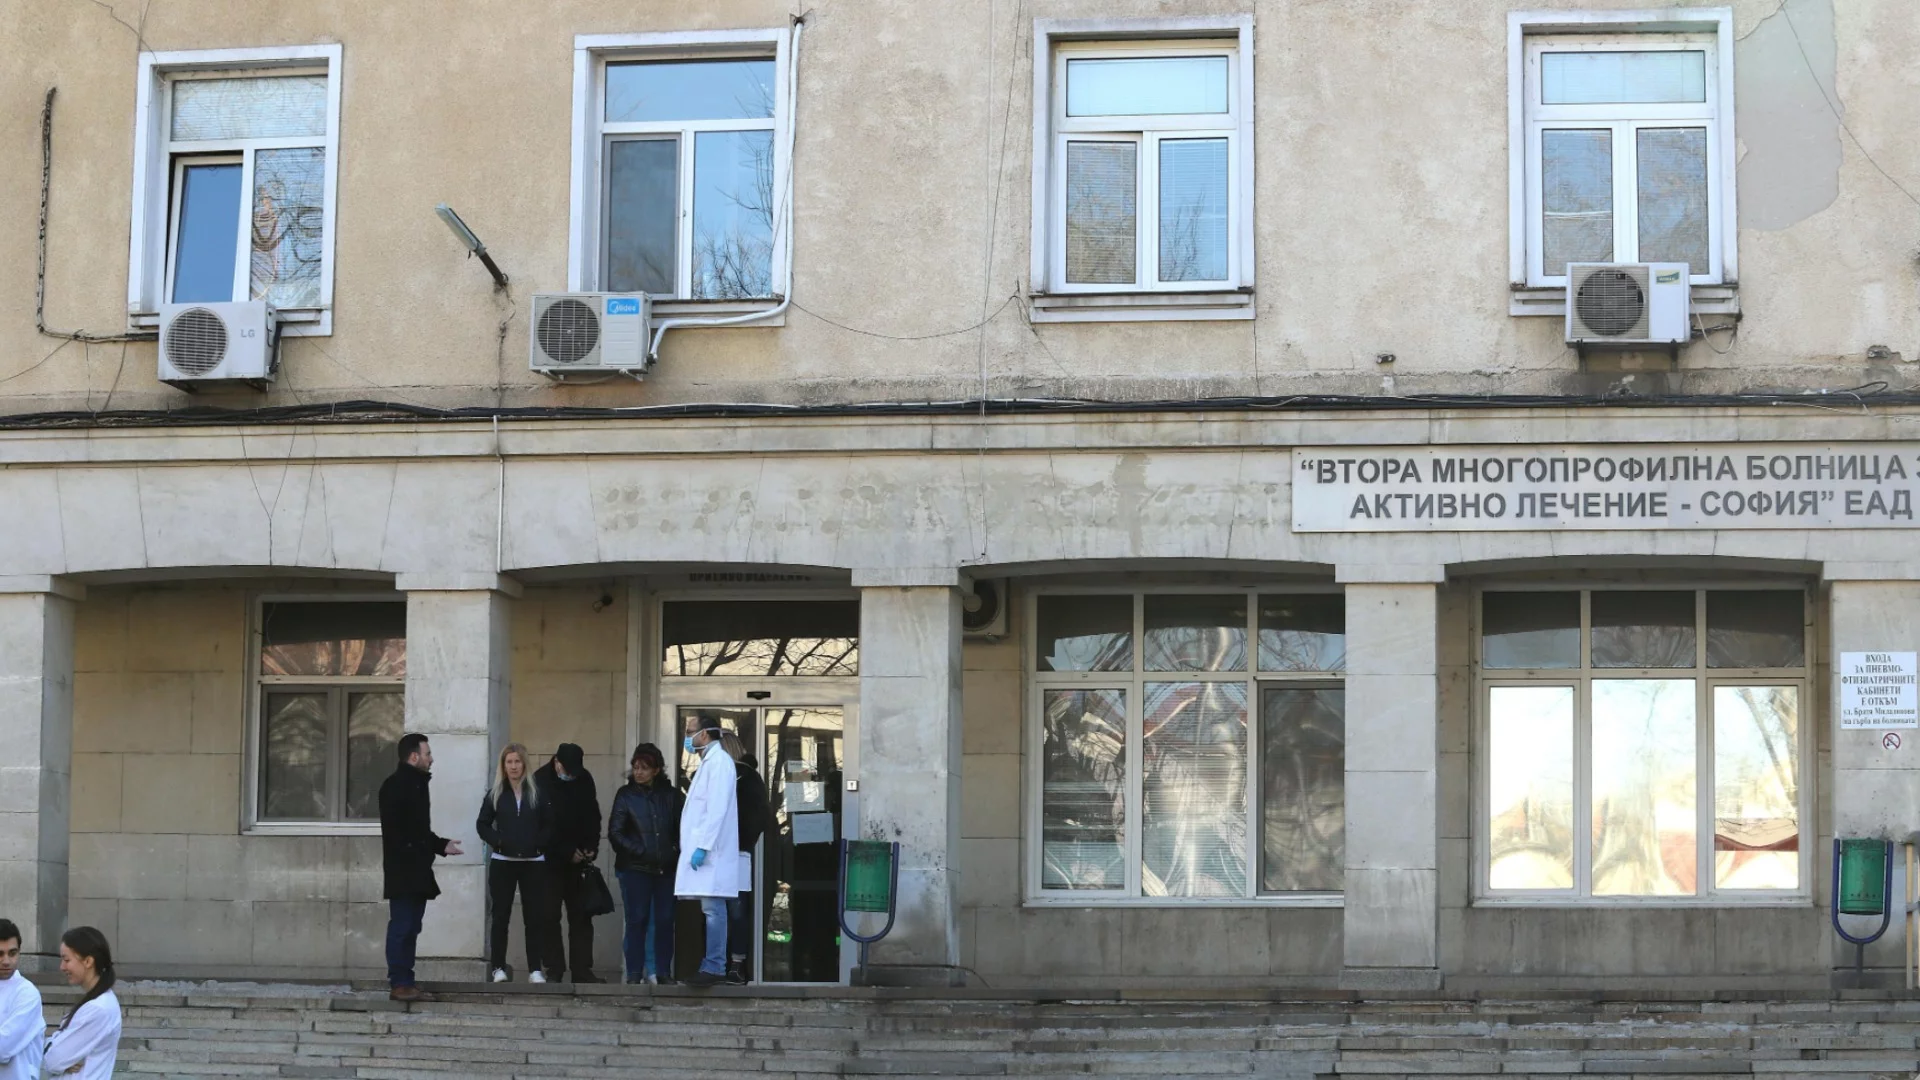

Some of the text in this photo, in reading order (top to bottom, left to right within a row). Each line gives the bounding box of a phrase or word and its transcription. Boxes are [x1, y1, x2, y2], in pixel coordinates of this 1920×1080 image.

[240, 329, 256, 338] LG
[1432, 455, 1738, 483] МНОГОПРОФИЛНА
[1746, 454, 1907, 484] БОЛНИЦА
[1350, 493, 1506, 519] АКТИВНО
[1515, 492, 1668, 518] ЛЕЧЕНИЕ
[1844, 489, 1913, 520] ЕАД
[1865, 654, 1892, 663] ВХОДА
[1855, 664, 1903, 674] ЗА ПНЕВМО-
[1841, 675, 1916, 684] ФТИЗИАТРИЧНИТЕ
[1857, 686, 1901, 695] КАБИНЕТИ
[1867, 697, 1898, 706] ОТКЪМ
[1854, 707, 1873, 717] Братя
